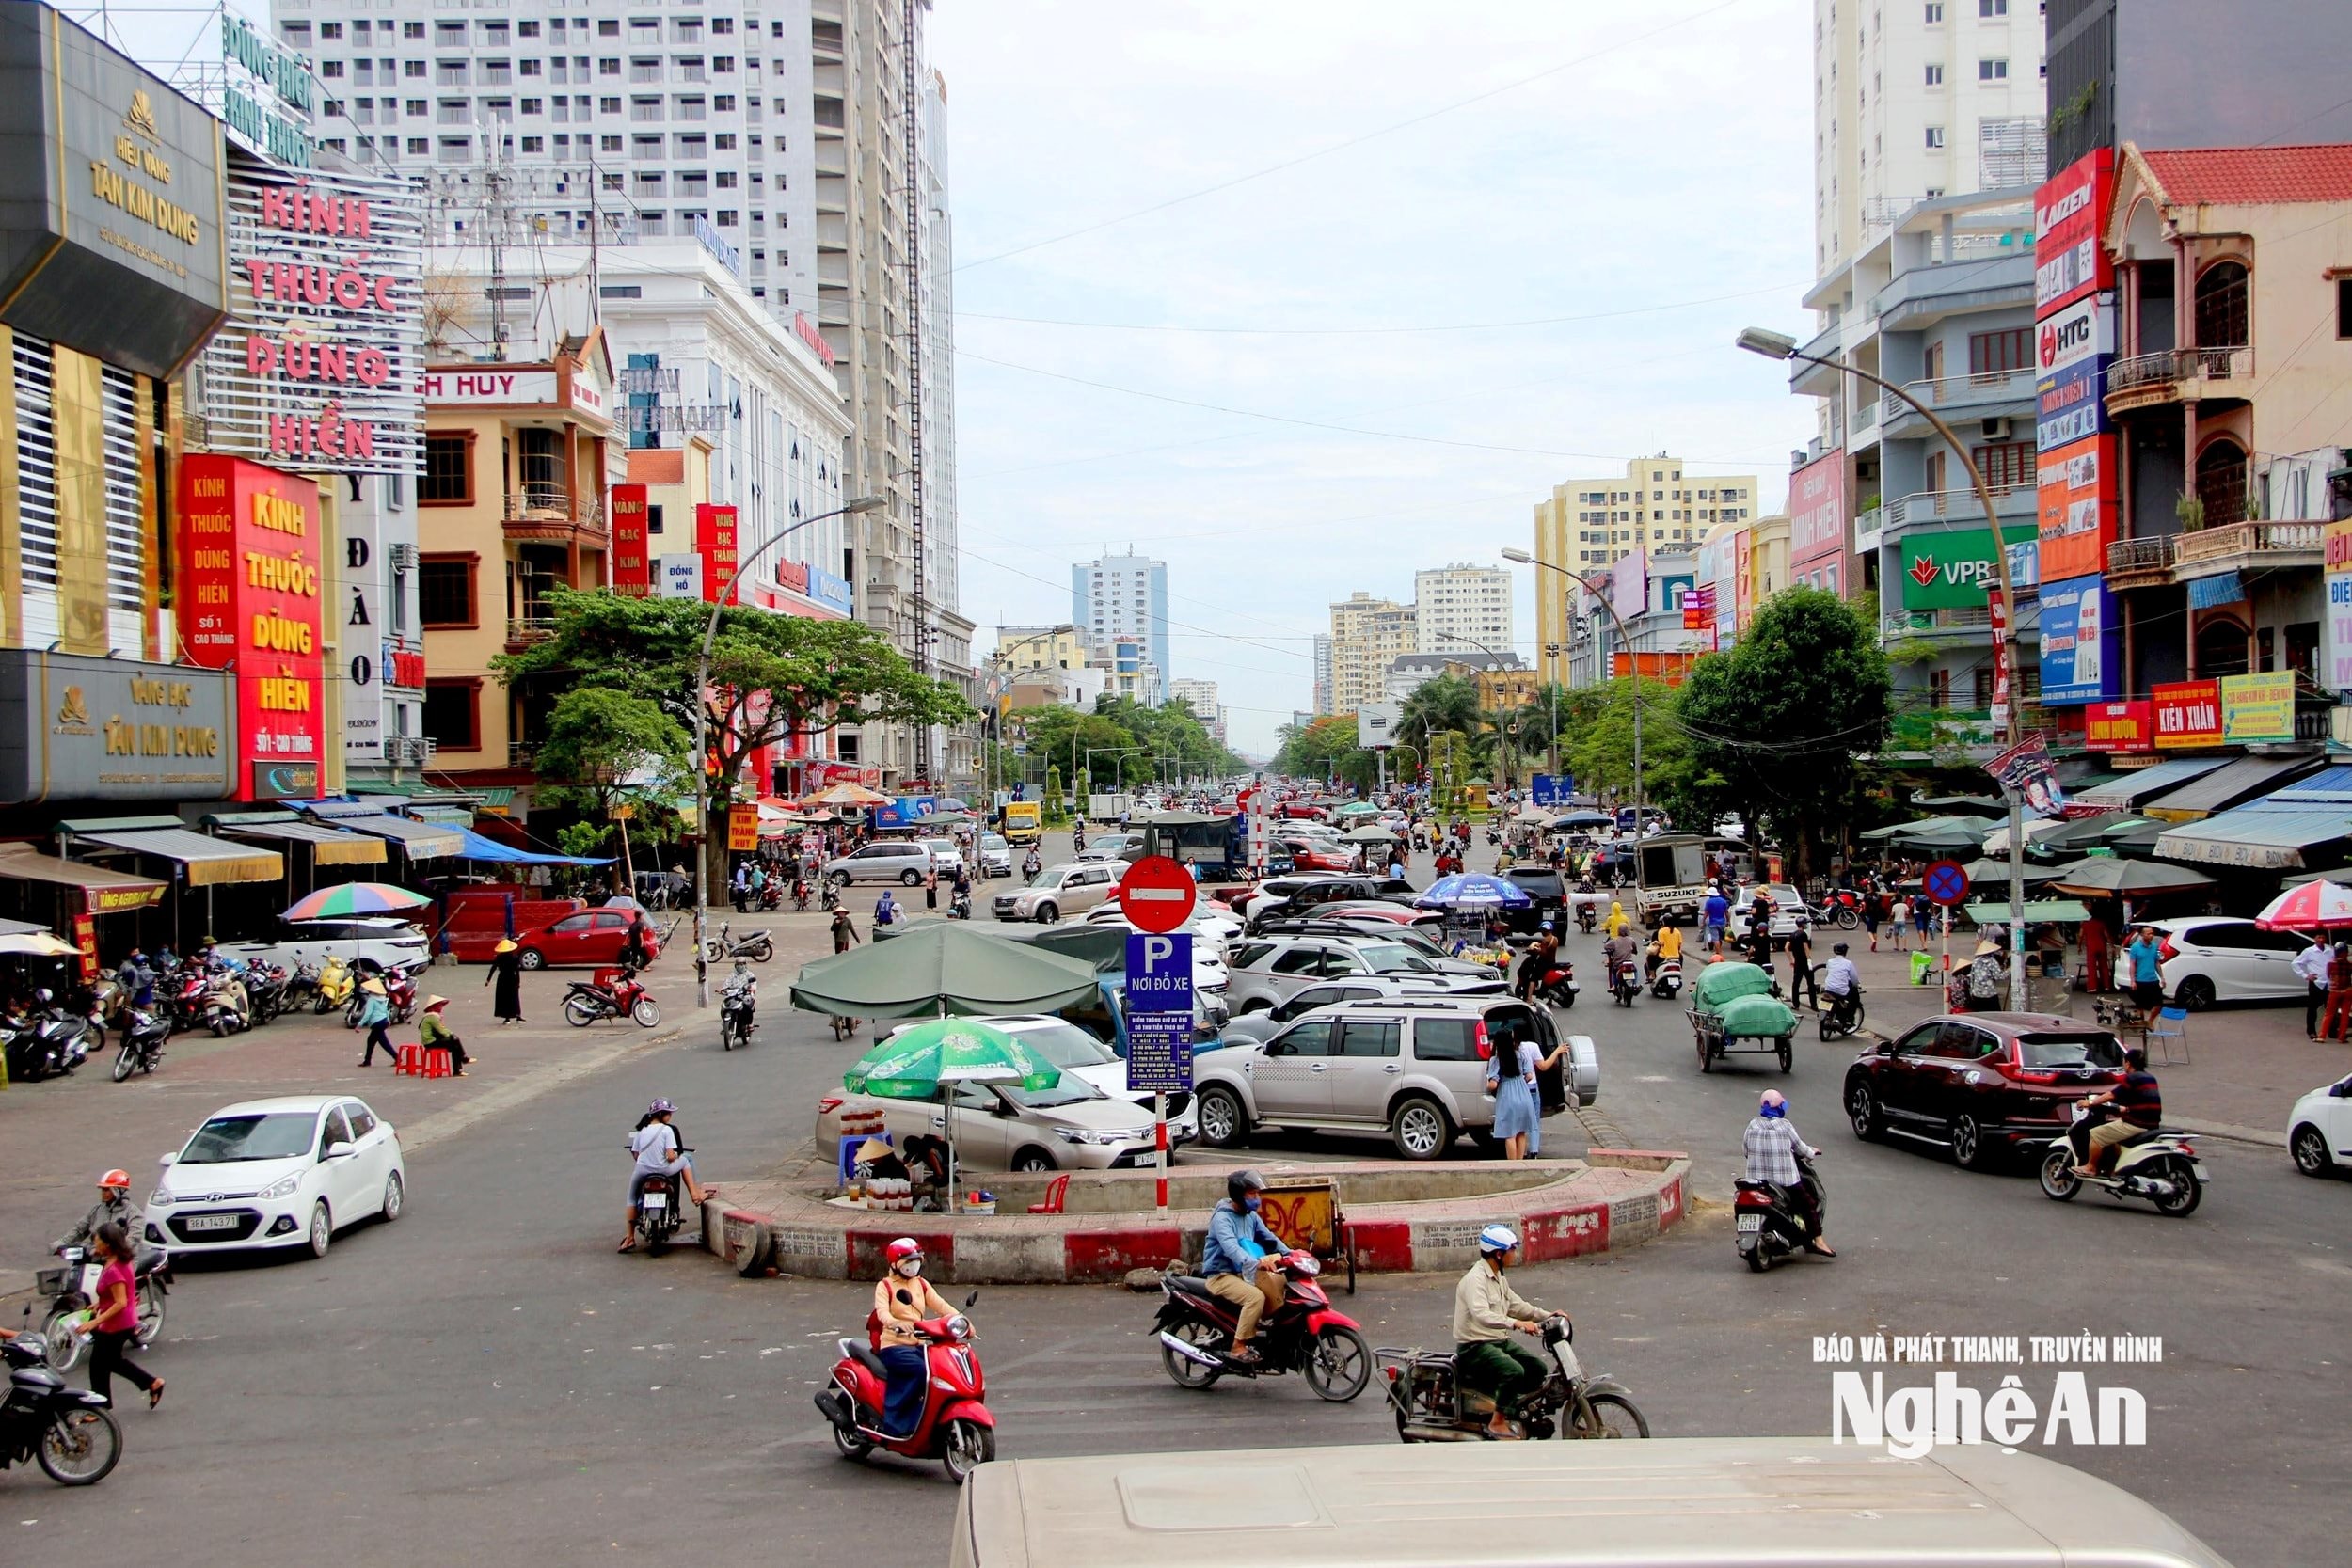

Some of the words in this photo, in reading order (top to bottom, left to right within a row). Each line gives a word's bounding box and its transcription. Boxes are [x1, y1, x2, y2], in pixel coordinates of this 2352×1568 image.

[116, 135, 140, 171] HIỆU
[143, 147, 171, 184] VÀNG
[90, 159, 123, 209] TÂN
[126, 181, 155, 226] KIM
[157, 197, 199, 246] DUNG
[262, 177, 371, 239] KÍNH
[245, 252, 398, 313] THUỐC
[2058, 315, 2089, 352] HTC
[247, 328, 389, 386] DŨNG
[458, 376, 515, 396] HUY
[270, 400, 373, 459] HIỀN
[194, 474, 226, 498] KÍNH
[251, 487, 306, 537] KÍNH
[613, 498, 644, 514] VÀNG
[190, 507, 232, 533] THUỐC
[1791, 509, 1815, 552] MINH
[619, 529, 640, 543] BẠC
[194, 546, 230, 569] DŨNG
[619, 557, 641, 568] KIM
[669, 564, 693, 576] ĐỒNG
[245, 550, 317, 597] THUỐC
[675, 578, 689, 591] HỒ
[1943, 560, 1990, 585] VPB
[198, 578, 229, 604] HIỀN
[199, 614, 215, 629] SỐ
[216, 617, 223, 628] 1
[252, 607, 312, 656] DŨNG
[194, 633, 210, 644] CAO
[131, 670, 166, 705] VÀNG
[168, 682, 192, 715] BẠC
[260, 664, 310, 713] HIỀN
[2159, 702, 2183, 732] KIÊN
[2186, 700, 2216, 731] XUÂN
[104, 714, 136, 756] TÂN
[174, 726, 219, 758] DUNG
[731, 825, 756, 837] THÀNH
[736, 815, 752, 825] KIM
[735, 839, 751, 848] HUY
[1144, 937, 1173, 974] P
[1132, 975, 1152, 990] NƠI
[1154, 972, 1171, 990] ĐỖ
[1174, 977, 1188, 990] XE
